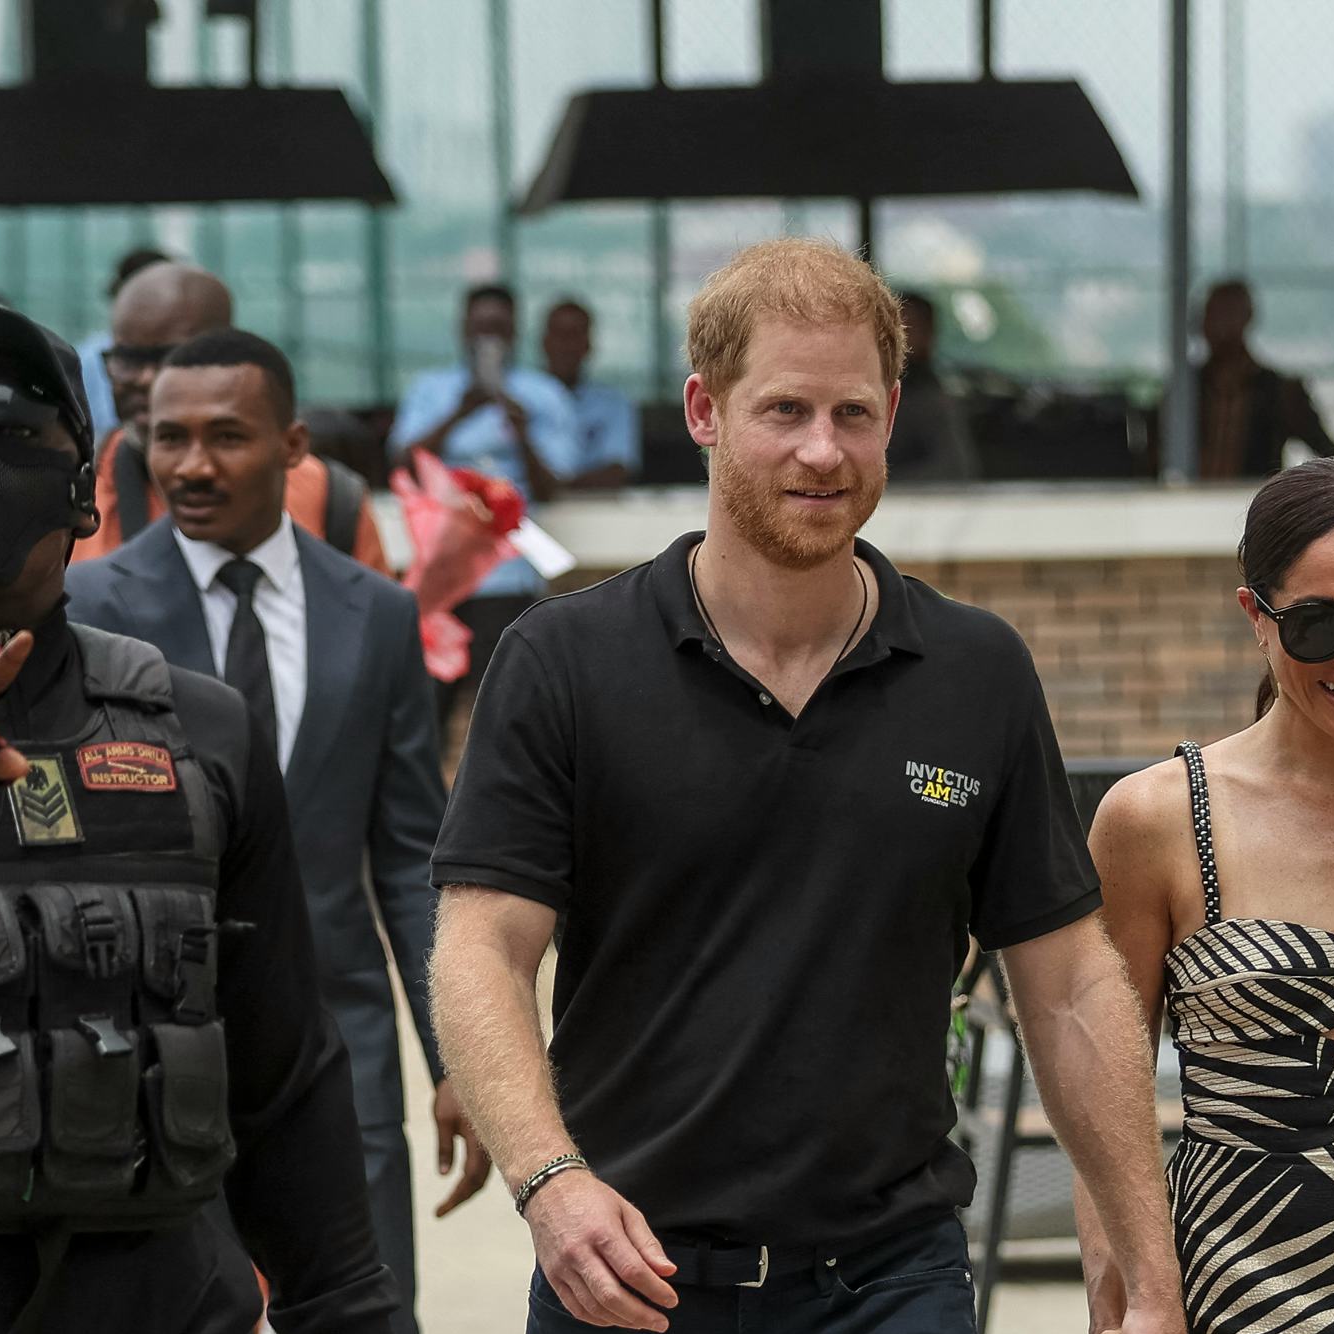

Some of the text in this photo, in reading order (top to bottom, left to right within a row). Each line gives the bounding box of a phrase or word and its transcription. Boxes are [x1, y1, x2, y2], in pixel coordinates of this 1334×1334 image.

[84, 746, 168, 762] ALL ARMS DRILL
[90, 773, 168, 785] INSTRUCTOR
[905, 760, 981, 796] INVICTUS
[910, 778, 968, 807] GAMES
[921, 795, 949, 807] FOUNDATION
